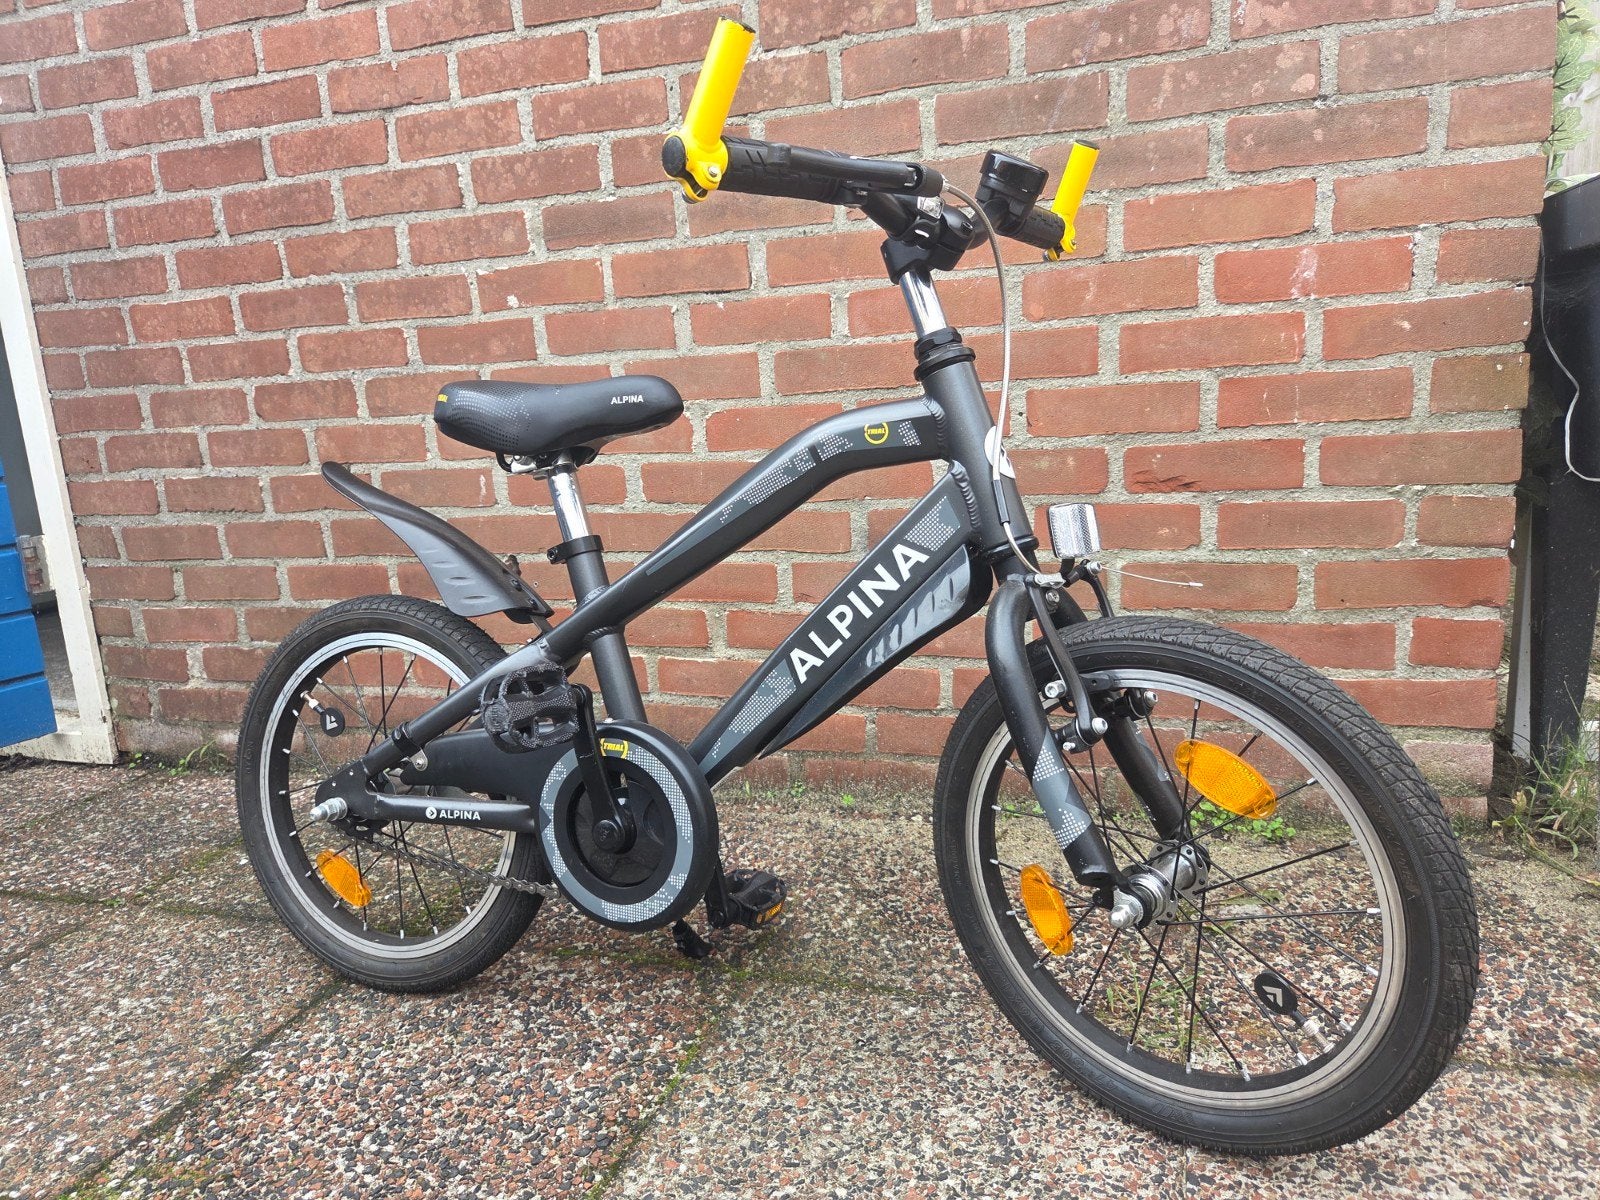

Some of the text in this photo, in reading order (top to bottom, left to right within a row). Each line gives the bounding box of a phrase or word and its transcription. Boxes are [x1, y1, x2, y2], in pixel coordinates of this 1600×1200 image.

[611, 394, 644, 405] ALPINA
[789, 543, 930, 685] ALPINA
[439, 809, 482, 821] ALPINA
